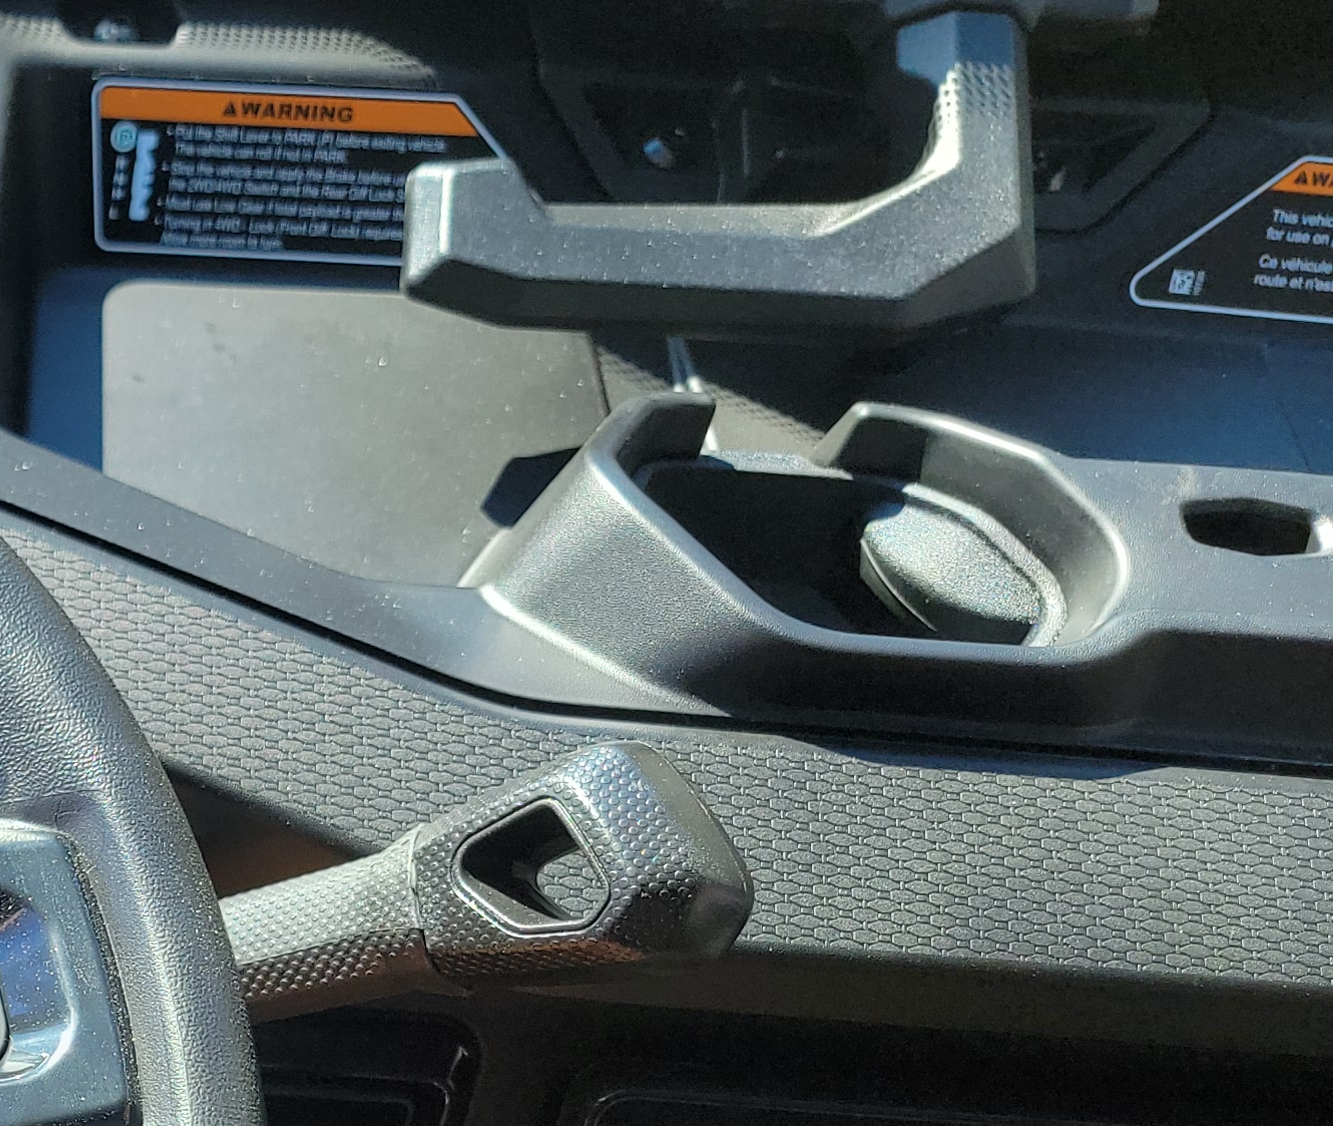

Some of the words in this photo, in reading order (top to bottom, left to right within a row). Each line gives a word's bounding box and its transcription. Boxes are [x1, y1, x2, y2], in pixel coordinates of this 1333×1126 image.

[243, 101, 354, 123] WARNING
[1273, 208, 1298, 225] This
[1265, 226, 1286, 241] for
[1286, 231, 1310, 244] use
[1313, 233, 1330, 246] on
